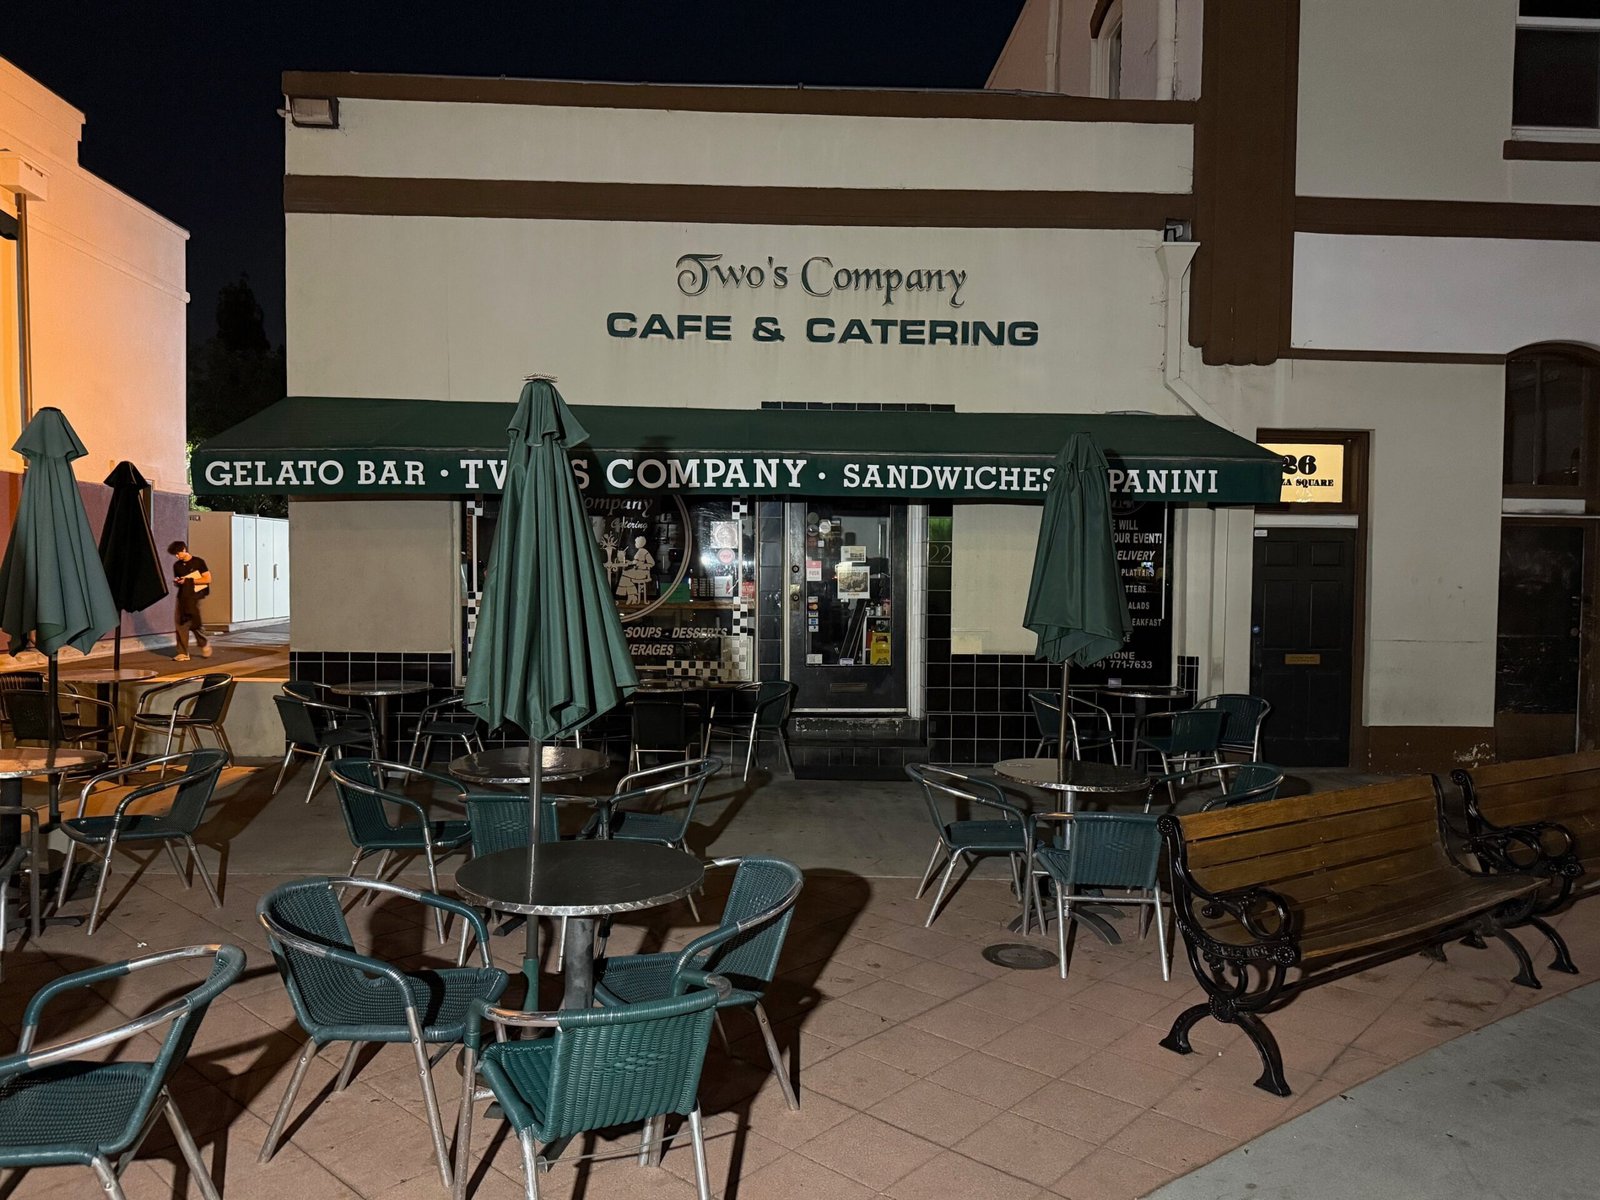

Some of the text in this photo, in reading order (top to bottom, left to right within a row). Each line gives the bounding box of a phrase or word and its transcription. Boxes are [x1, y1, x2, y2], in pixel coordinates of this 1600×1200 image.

[676, 253, 967, 308] Two's Company
[607, 312, 1039, 346] CAFE & CATERING
[205, 460, 344, 486] GELATO
[357, 460, 426, 486] BAR
[606, 458, 808, 489] COMPANY
[1107, 469, 1219, 494] PANINI
[1296, 479, 1334, 488] SQUARE
[584, 496, 653, 518] ompany
[1118, 519, 1138, 531] WILL
[1113, 532, 1163, 544] OUR EVENT!
[929, 544, 952, 563] 22
[1116, 550, 1156, 561] ELIVERY
[1125, 584, 1147, 593] TTERS
[1127, 601, 1150, 610] ALADS
[1131, 618, 1162, 627] EAKFAST
[625, 626, 662, 638] SOUPS
[629, 644, 675, 656] ERAGES
[1109, 660, 1153, 669] 771-7633
